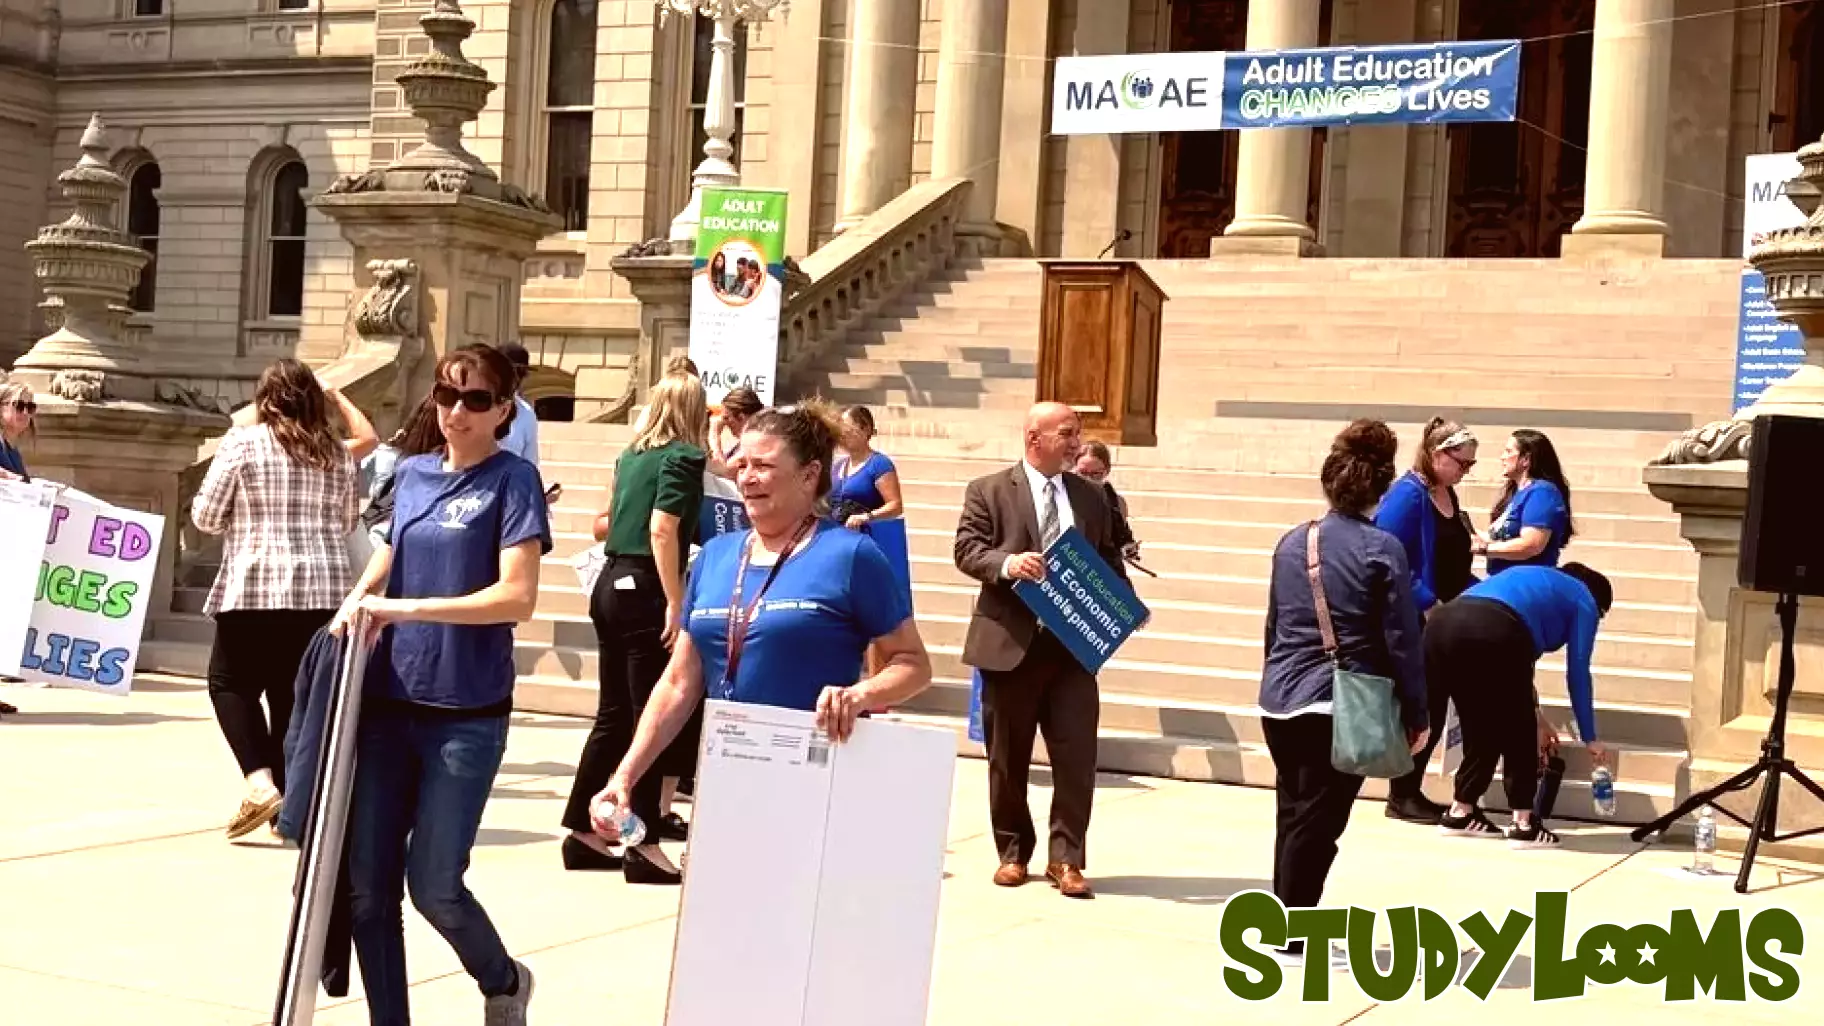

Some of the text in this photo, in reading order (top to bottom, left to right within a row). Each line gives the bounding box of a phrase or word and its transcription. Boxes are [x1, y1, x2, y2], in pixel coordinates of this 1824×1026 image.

[1243, 52, 1493, 86] Adult Education
[1240, 85, 1491, 119] CHANGES Lives
[703, 216, 779, 233] EDUCATION
[721, 198, 765, 213] ADULT
[88, 515, 152, 561] ED
[1048, 553, 1122, 639] is Economic
[1060, 542, 1135, 624] Adult Education
[1040, 580, 1110, 656] evelopment
[21, 627, 130, 685] LIES
